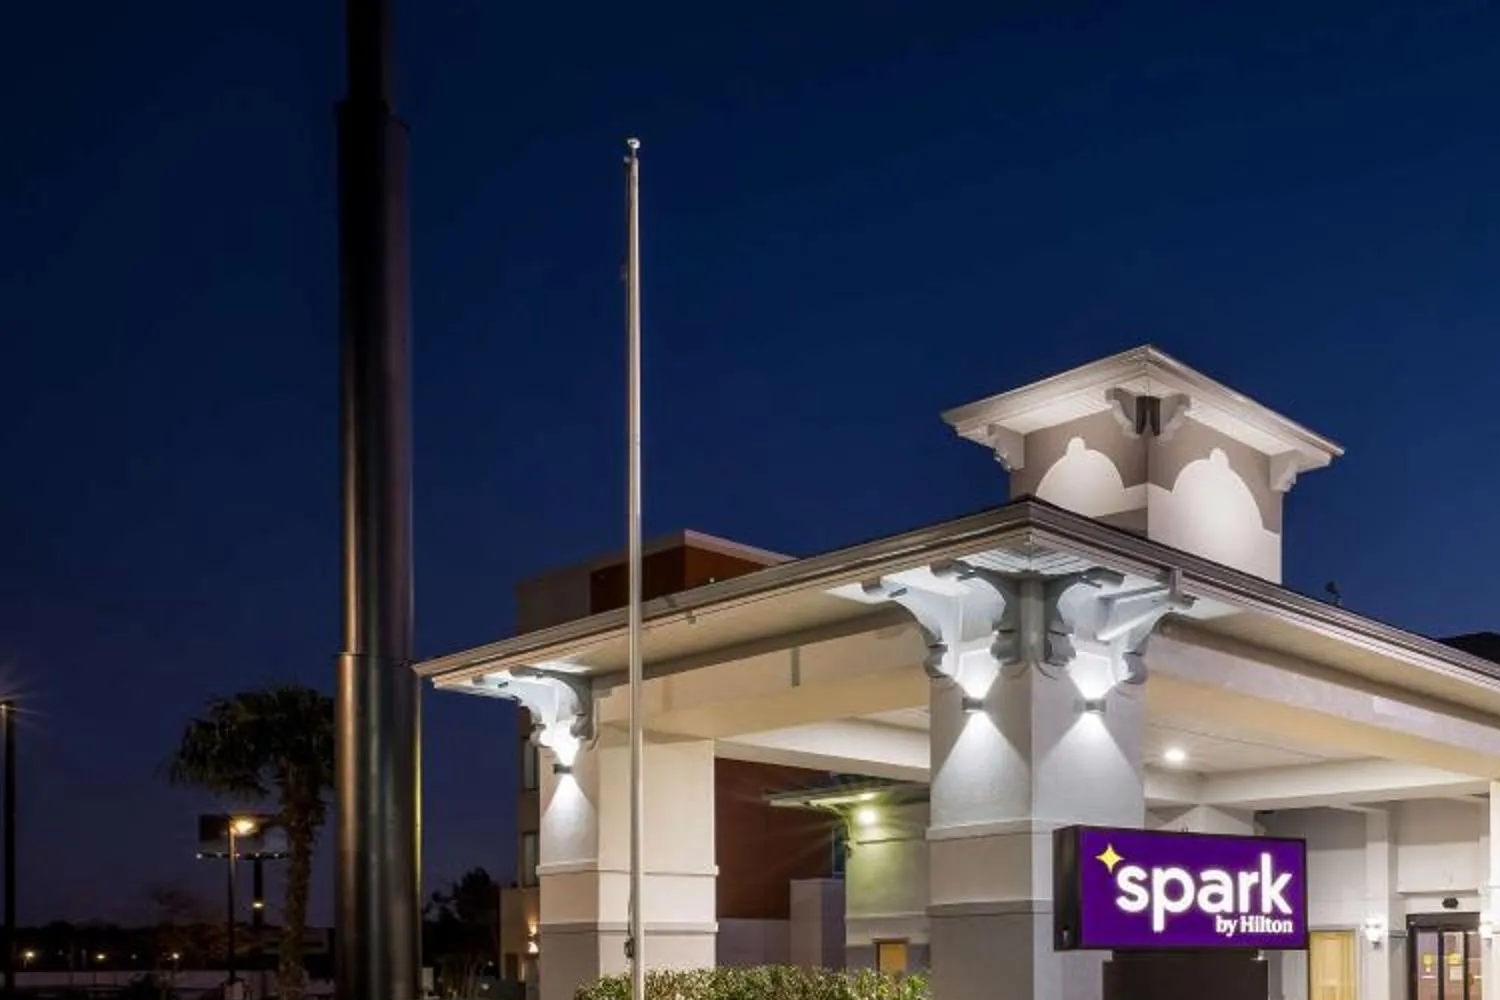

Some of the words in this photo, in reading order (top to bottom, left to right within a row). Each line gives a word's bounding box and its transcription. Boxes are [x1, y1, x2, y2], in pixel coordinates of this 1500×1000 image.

[1115, 852, 1293, 932] spark
[1215, 915, 1238, 938] by
[1240, 915, 1293, 933] Hilton
